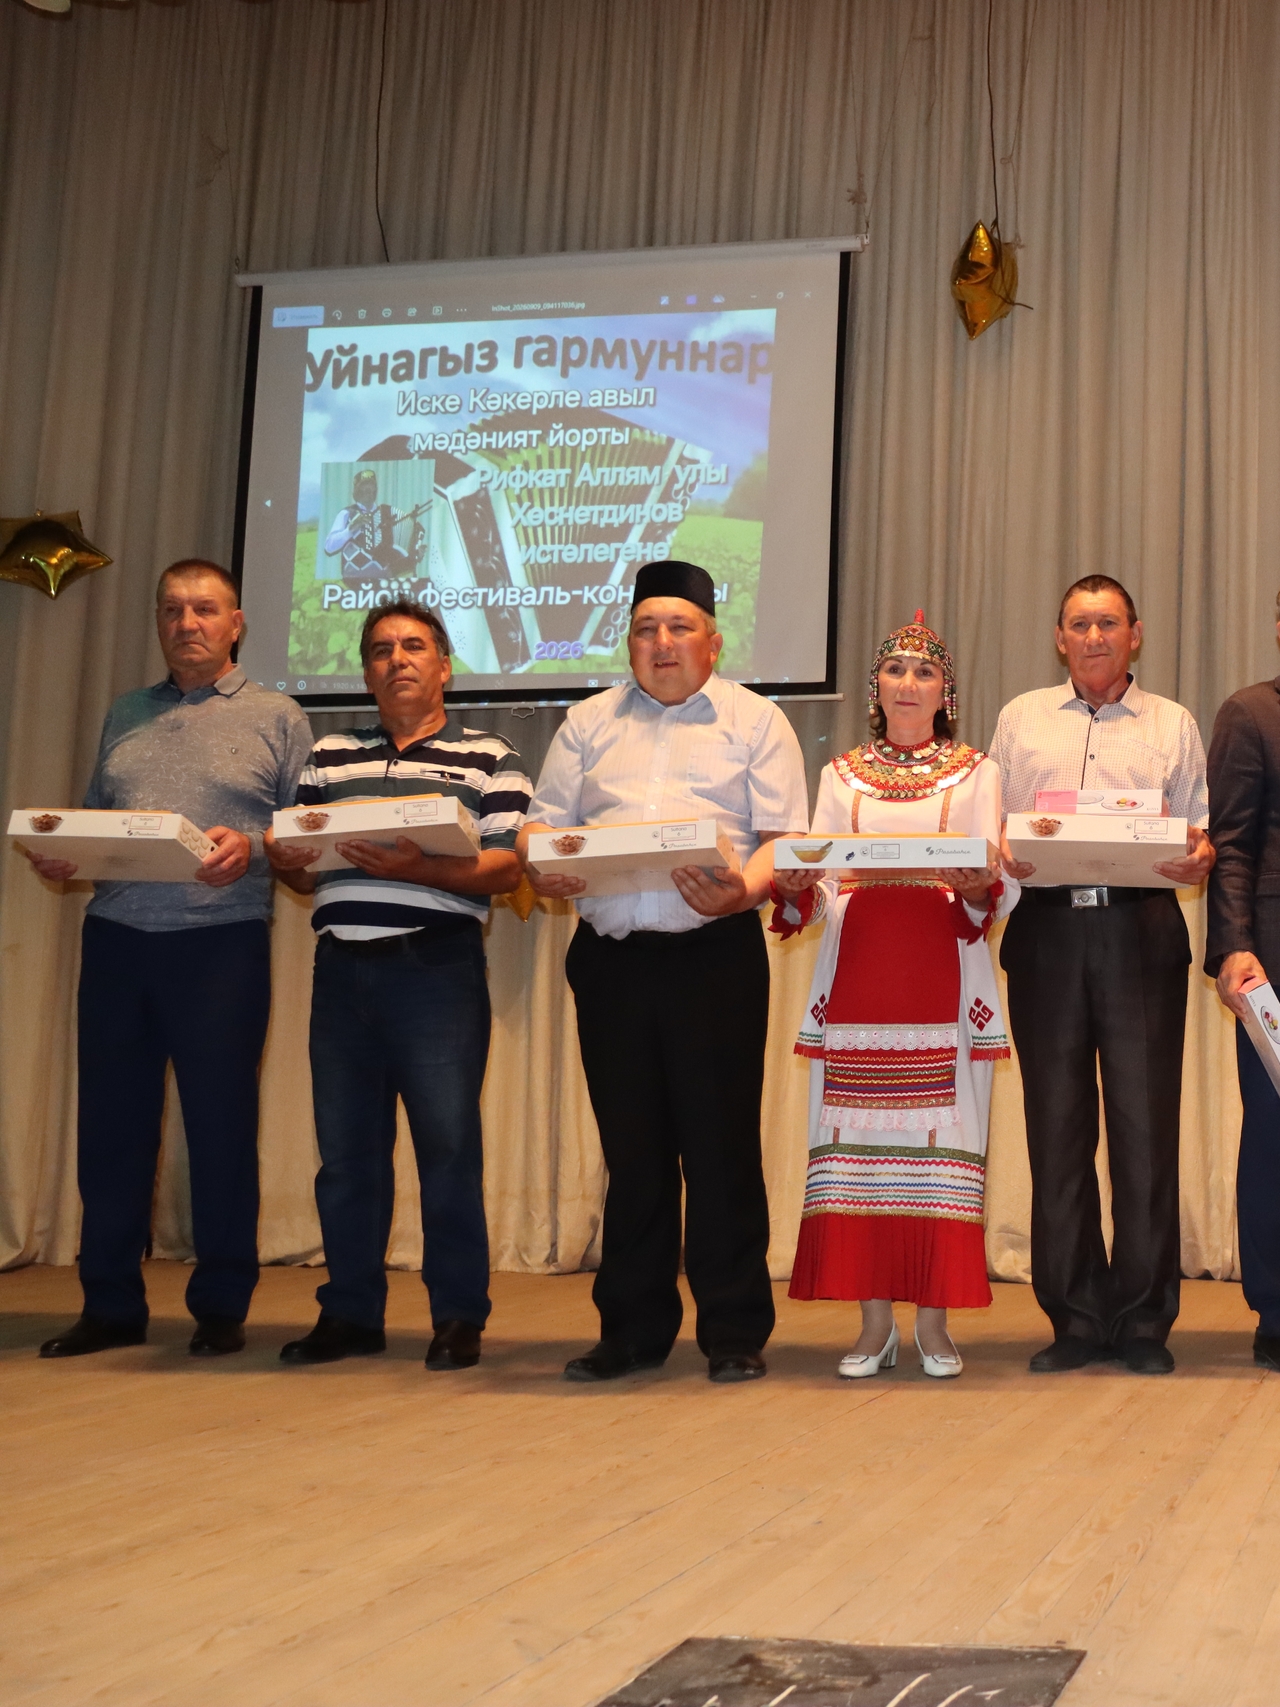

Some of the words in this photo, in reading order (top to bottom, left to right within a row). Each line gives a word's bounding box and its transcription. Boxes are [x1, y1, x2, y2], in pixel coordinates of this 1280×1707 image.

[305, 340, 498, 392] Уйнагыз
[513, 335, 773, 385] гармуннар
[398, 390, 461, 414] Иске
[469, 388, 581, 415] Кәкерле
[588, 387, 655, 407] авыл
[414, 430, 542, 453] мәдәният
[549, 423, 630, 451] йорты
[476, 464, 571, 494] Рифкат
[575, 463, 661, 487] Аллям
[674, 463, 728, 490] улы
[418, 582, 728, 608] фестиваль-коны
[534, 641, 584, 660] 2026
